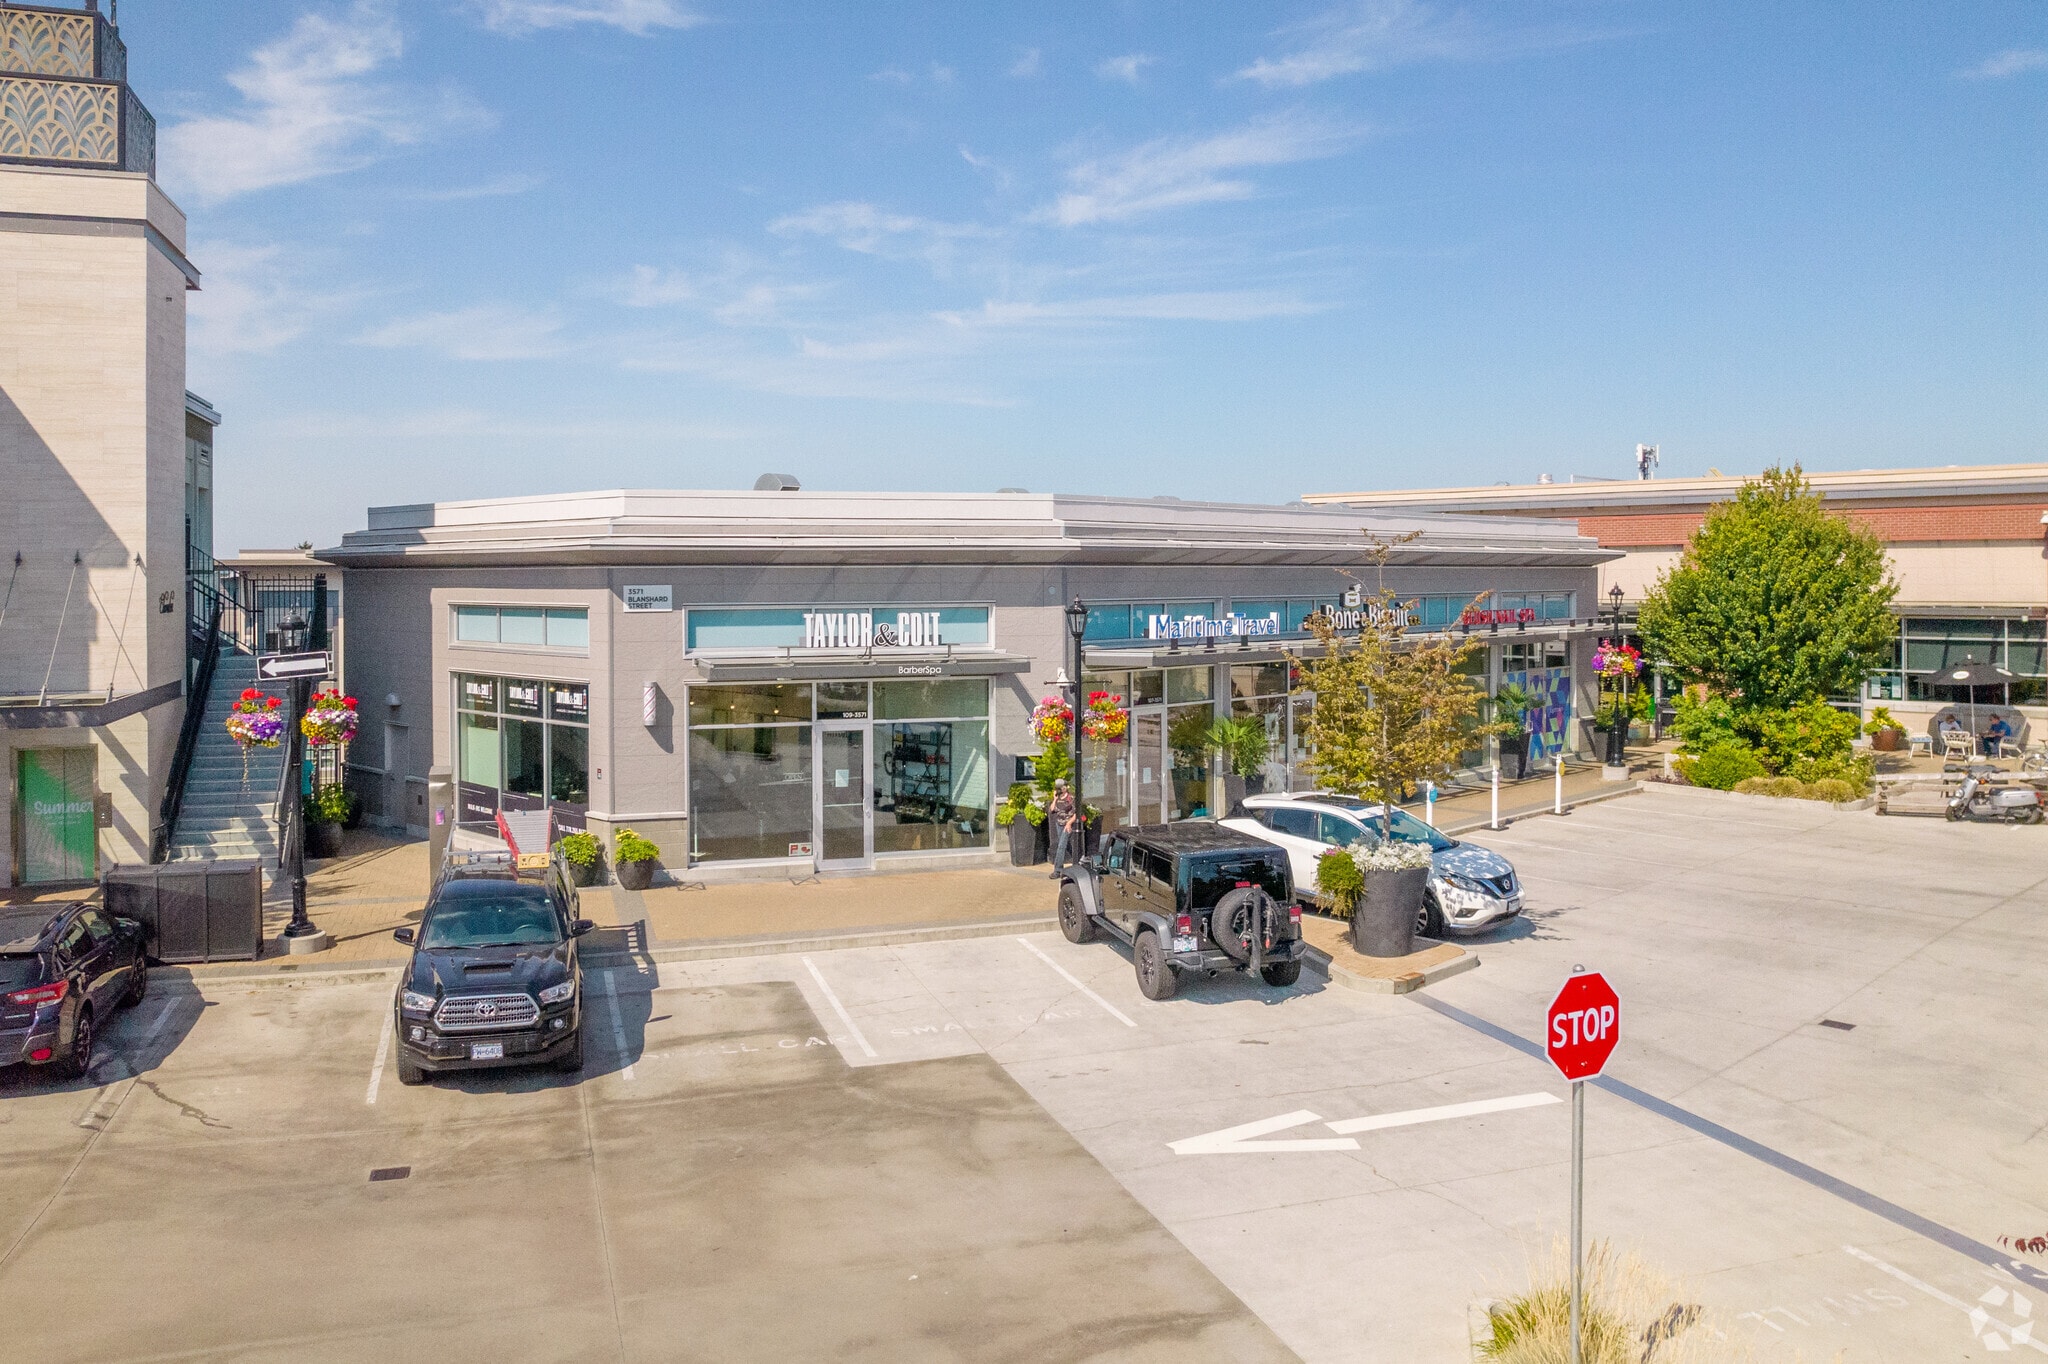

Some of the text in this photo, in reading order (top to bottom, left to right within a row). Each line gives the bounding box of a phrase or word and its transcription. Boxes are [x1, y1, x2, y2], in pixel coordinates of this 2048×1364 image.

[1150, 615, 1233, 639] Maritime
[1230, 612, 1280, 635] Travel
[1325, 604, 1360, 629] Bone
[1496, 609, 1517, 624] NAIL
[1519, 608, 1537, 623] SPA
[898, 666, 942, 675] BarberSpa
[34, 800, 95, 815] Summer
[1552, 1005, 1615, 1049] STOP
